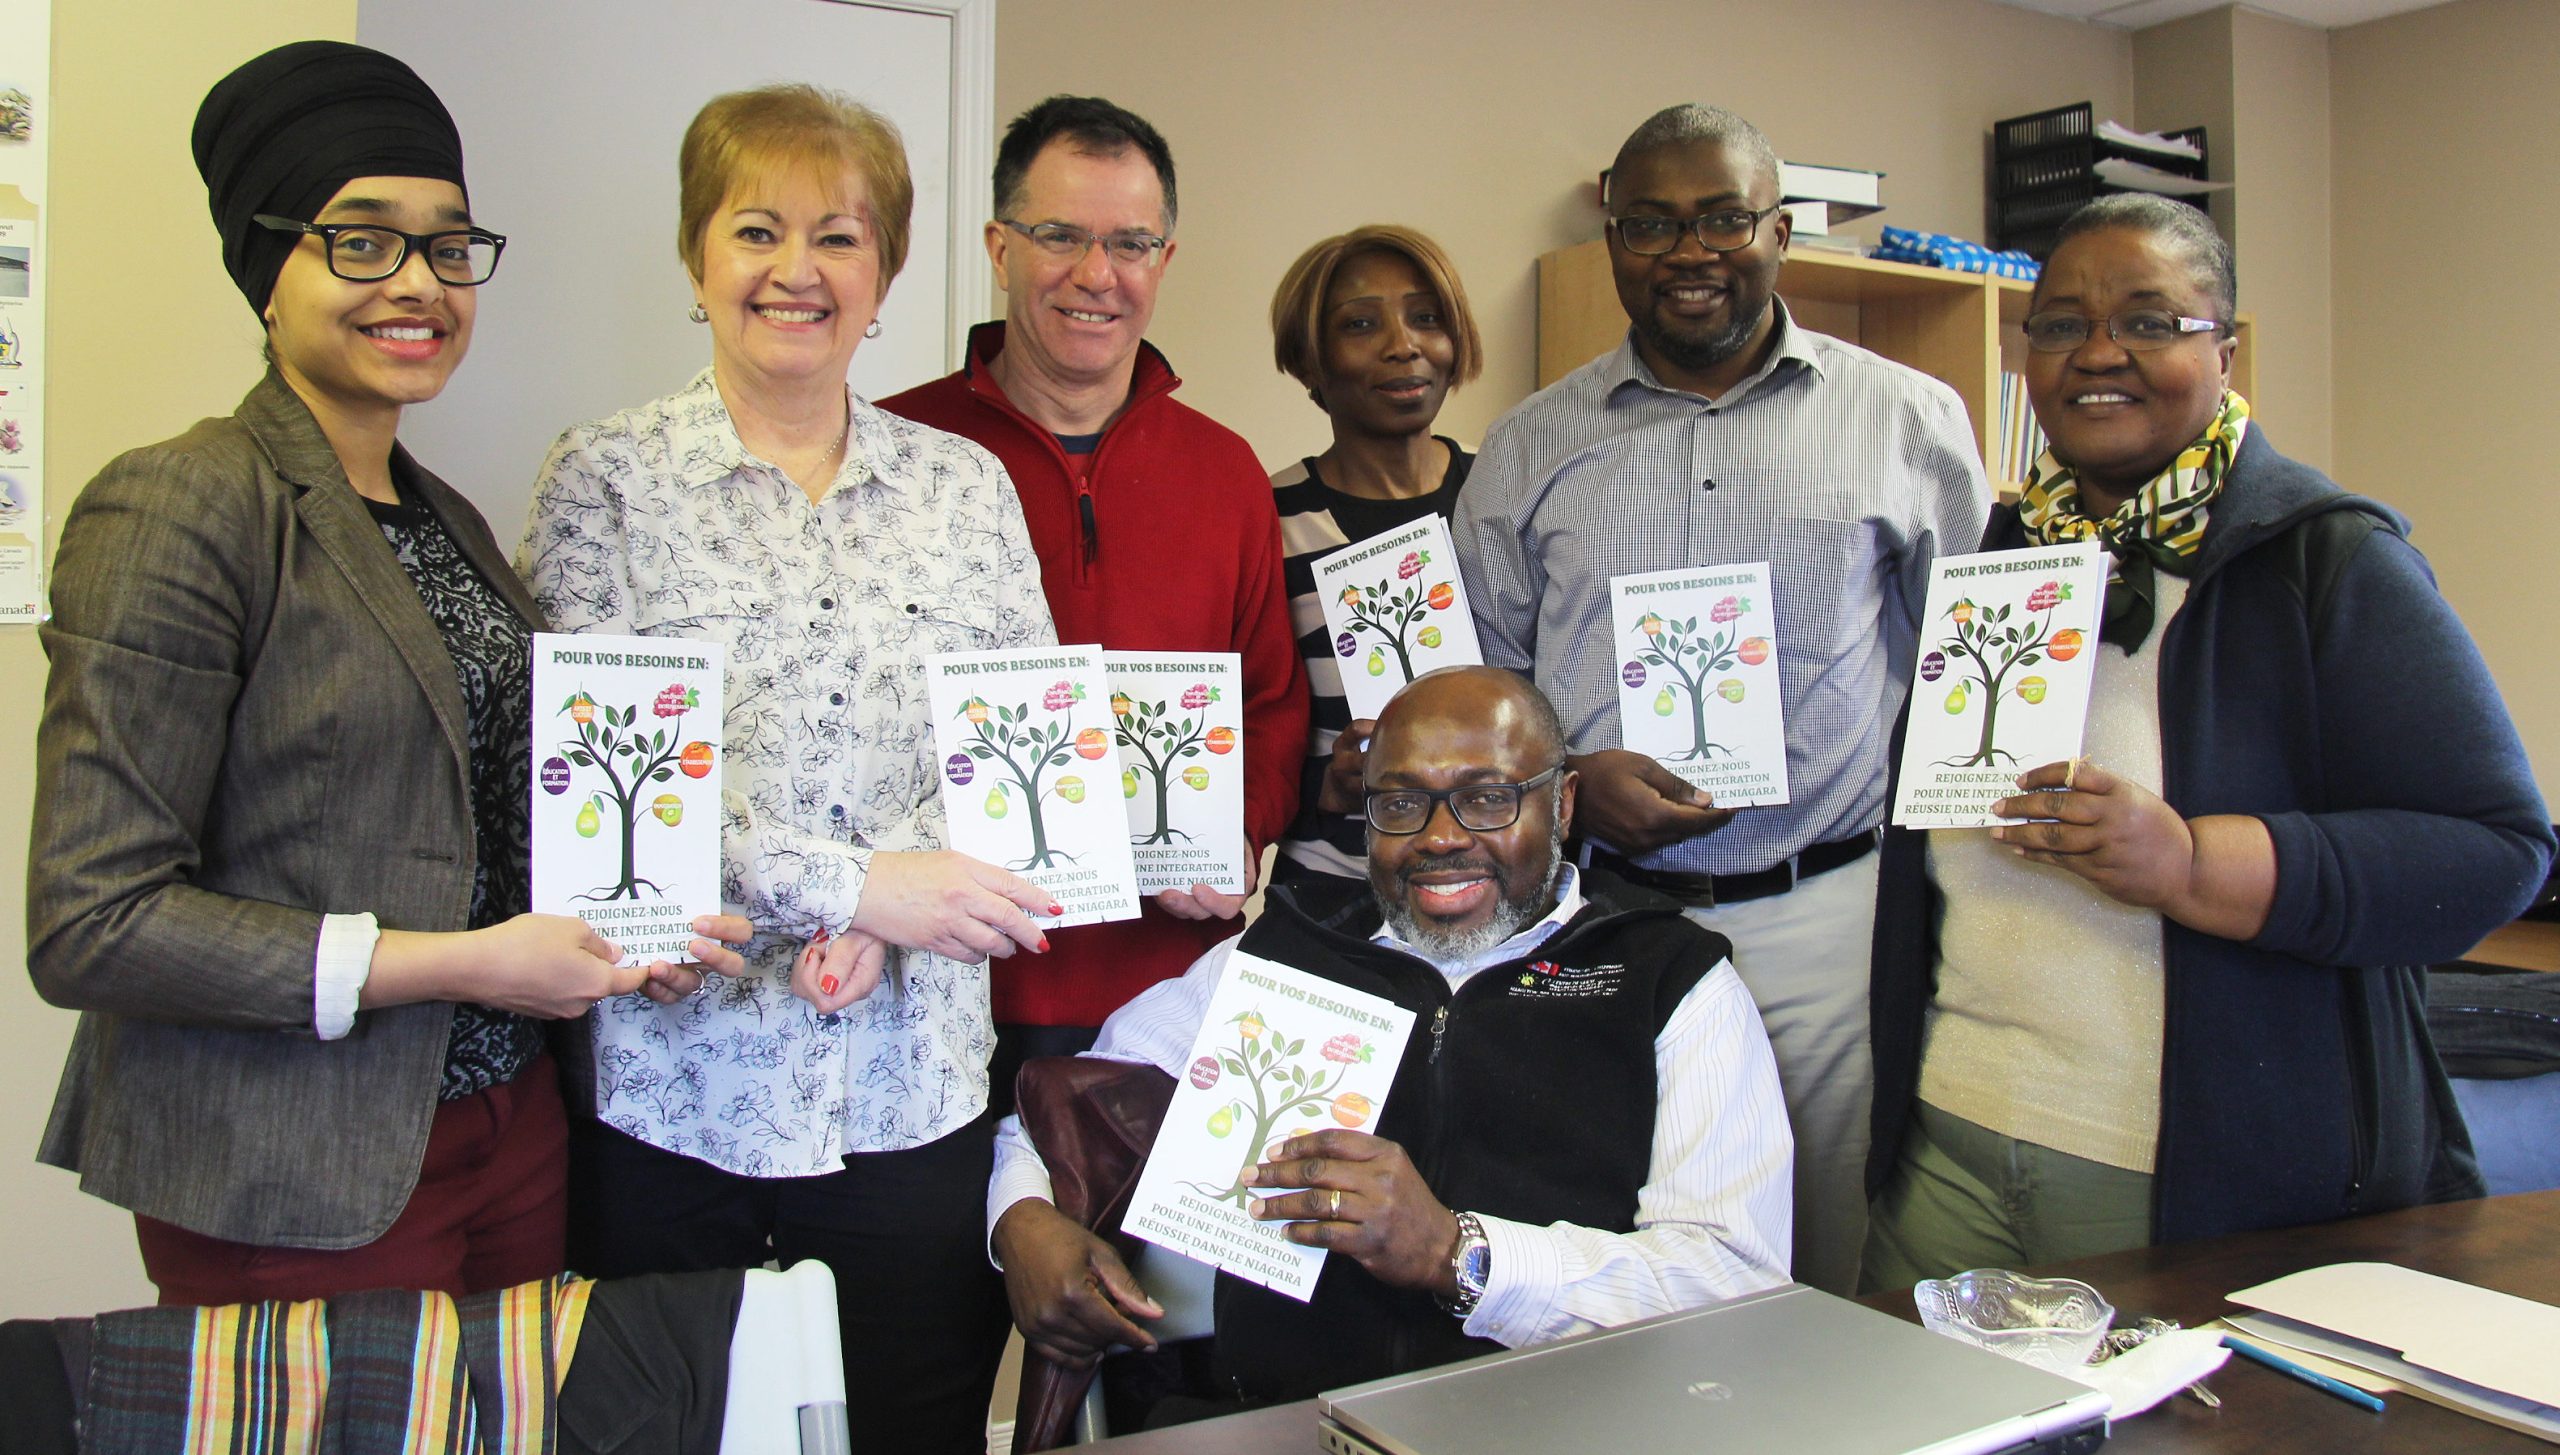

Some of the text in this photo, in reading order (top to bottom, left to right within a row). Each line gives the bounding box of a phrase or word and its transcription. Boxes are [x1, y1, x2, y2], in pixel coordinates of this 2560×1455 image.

[1323, 527, 1431, 576] POUR VOS BESOINS EN:
[1943, 556, 2084, 579] POUR VOS BESOINS EN:
[1624, 573, 1757, 596] POUR VOS BESOINS EN:
[0, 603, 36, 615] anada
[553, 650, 709, 670] POUR VOS BESOINS EN:
[943, 656, 1090, 676] POUR VOS BESOINS EN:
[1105, 663, 1228, 673] OUR VOS BESOINS EN:
[1668, 761, 1750, 775] EJOIGNEZ-NOUS
[1697, 773, 1770, 787] INTEGRATION
[1935, 773, 2020, 783] REJOIGNEZ-N
[1714, 786, 1777, 799] LE NIAGARA
[1913, 789, 2026, 799] POUR UNE INTEGR
[1905, 802, 1952, 814] RÉUSSIE
[1954, 804, 1985, 814] DANS
[1134, 850, 1210, 859] JOIGNEZ-NOUS
[1156, 863, 1228, 872] INTEGRATION
[1027, 870, 1098, 886] IGNEZ-NOUS
[1142, 877, 1234, 886] DANS LE NIAGARA
[1051, 883, 1120, 900] TEGRATION
[578, 905, 683, 921] REJOIGNEZ-NOUS
[1077, 898, 1128, 913] NIAGARA
[621, 922, 694, 938] INTEGRATIO
[622, 940, 691, 955] NS LE NIAG
[1239, 969, 1394, 1033] POUR VOS BESOINS EN:
[1179, 1194, 1286, 1243] REJOIGNEZ-NOUS
[1151, 1203, 1302, 1268] POUR UNE INTEGRATION
[1138, 1216, 1302, 1287] RÉUSSIE DANS LE NIAGARA
